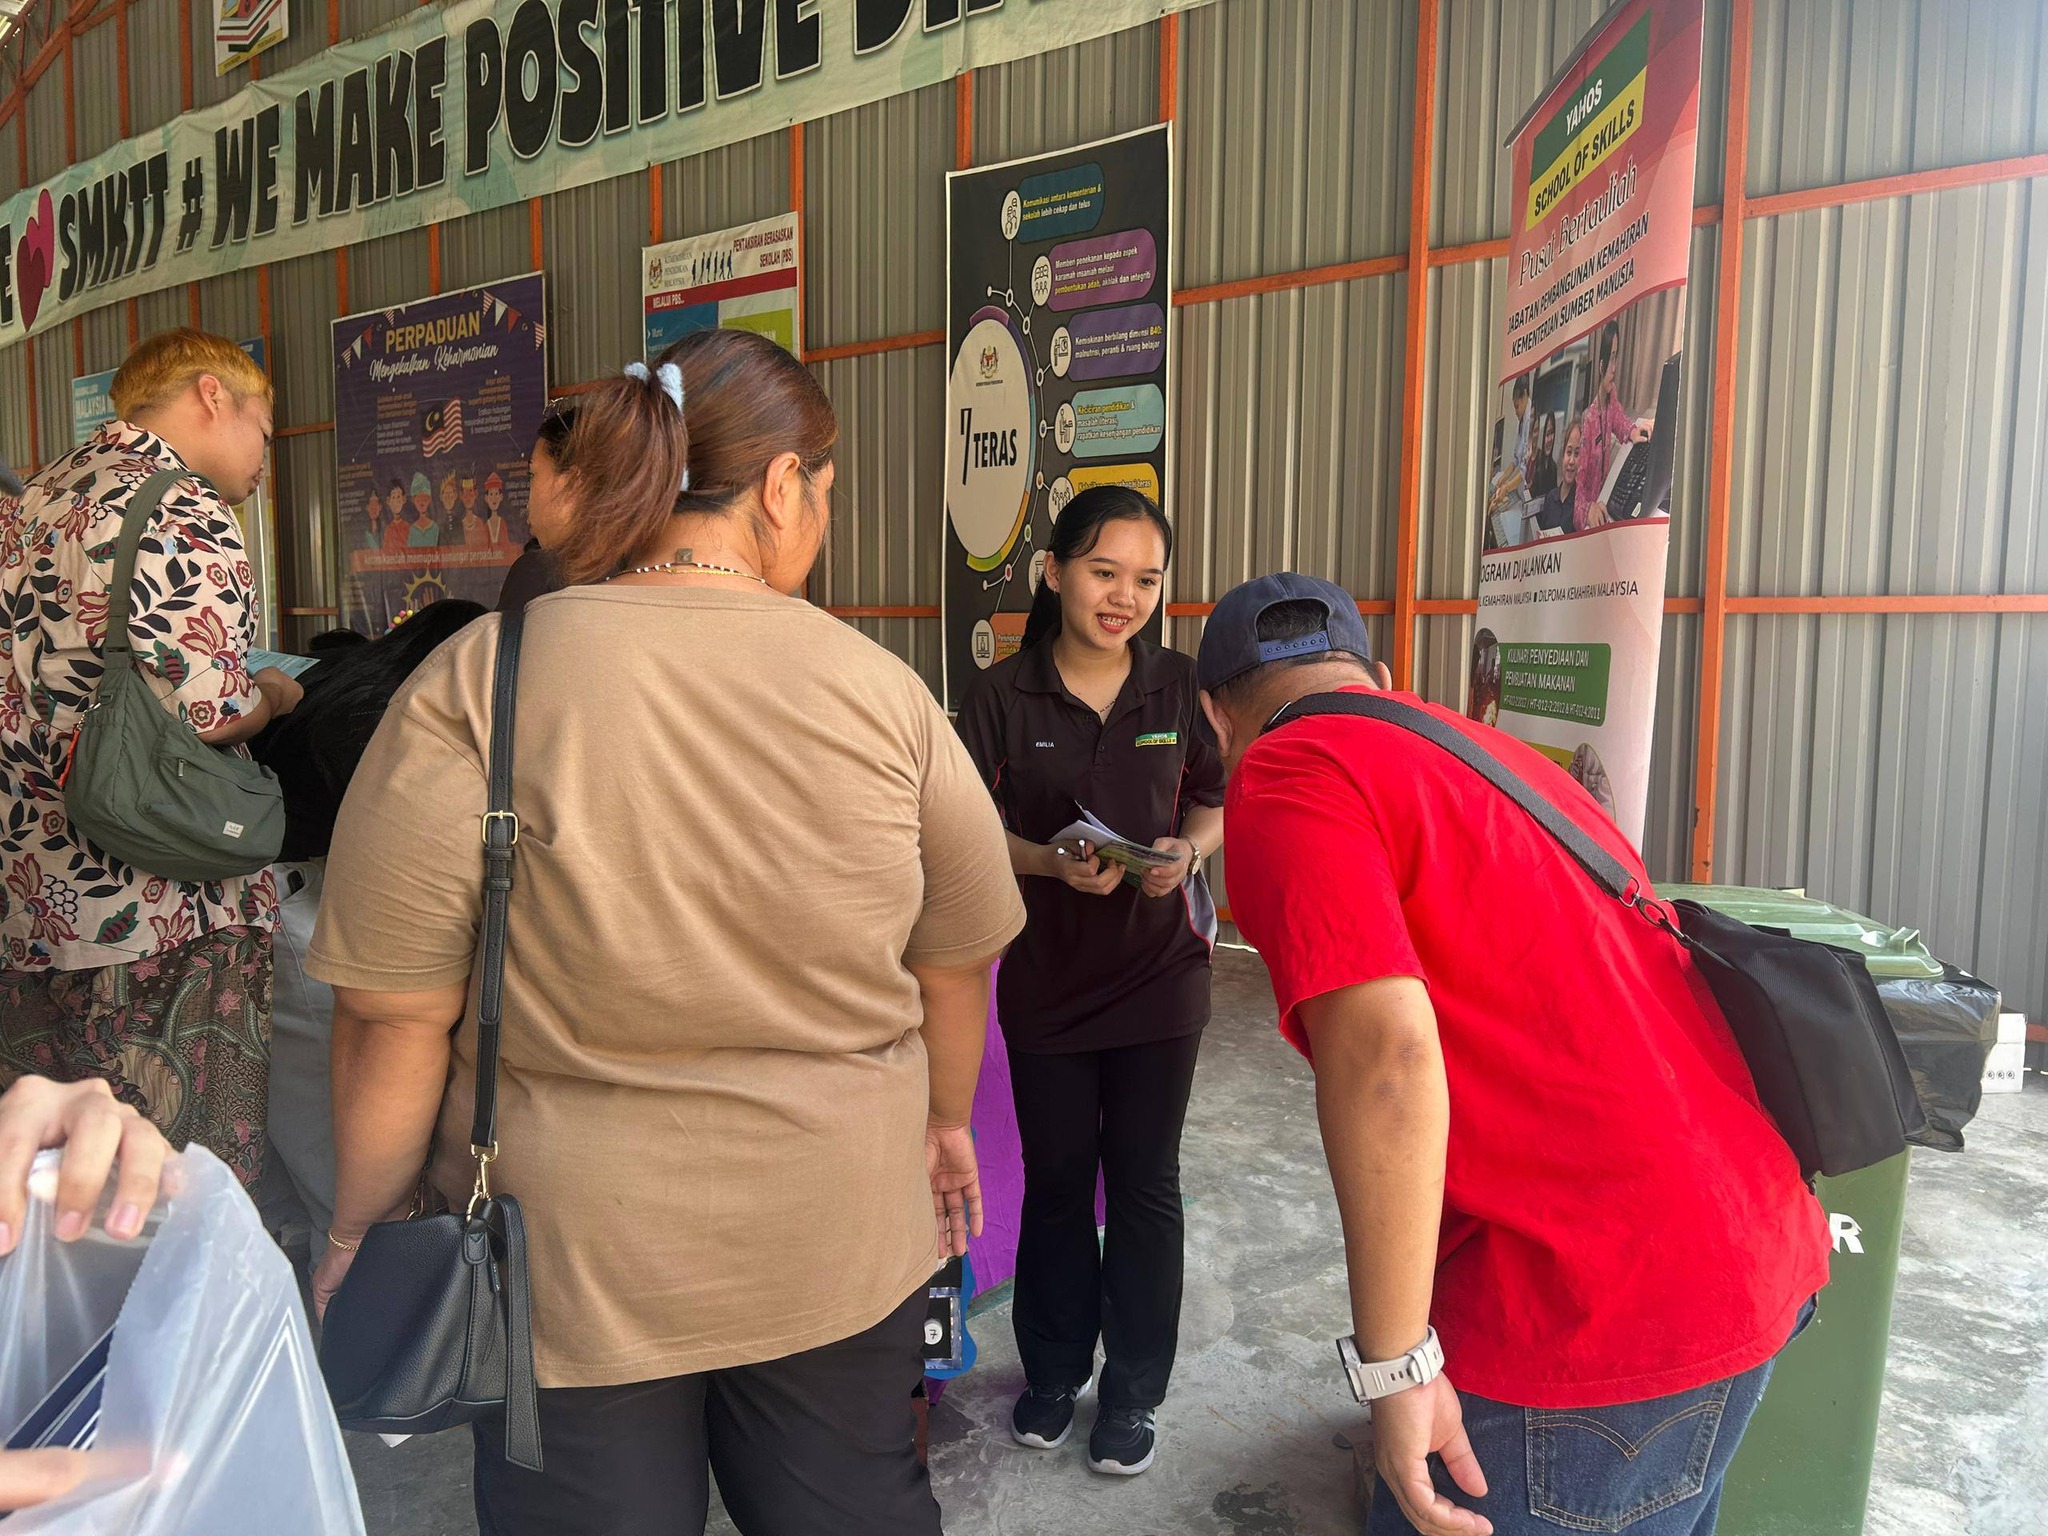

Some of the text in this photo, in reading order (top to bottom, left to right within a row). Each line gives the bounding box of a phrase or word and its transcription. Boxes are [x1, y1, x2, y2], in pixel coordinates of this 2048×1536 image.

[1566, 79, 1603, 136] YAHOS
[58, 150, 169, 304] SMKTT
[292, 33, 448, 226] MAKE
[1534, 99, 1635, 217] SCHOOL OF SKILLS
[1041, 207, 1053, 217] lebih
[1053, 205, 1068, 215] cekap
[1068, 202, 1078, 212] dan
[1078, 199, 1091, 209] telus
[1518, 155, 1637, 288] Pusat Bertauliah
[764, 226, 793, 246] BERASASKAN
[760, 251, 780, 267] SEKOLAH
[1103, 250, 1122, 261] kepada
[1122, 246, 1138, 257] aspek
[1119, 274, 1129, 283] dan
[1507, 210, 1650, 335] JABATAN PEMBANGUNAN KEMAHIRAN
[1511, 257, 1635, 358] KEMENTERIAN SUMBER MANUSIA
[385, 310, 482, 354] PERPADUAN
[1075, 335, 1104, 345] Kemiskinan
[1104, 331, 1128, 342] berbilang
[1128, 327, 1149, 339] dimensi
[1121, 344, 1125, 353] &
[1126, 343, 1141, 353] ruang
[1141, 340, 1161, 351] belajar
[369, 342, 500, 383] Mengekalkan Keharmonian
[1132, 424, 1161, 438] pendidikan
[960, 407, 1017, 486] 7 TERAS
[1512, 552, 1562, 582] DIJALANKAN
[1482, 594, 1513, 607] KEMAHIRAN
[1538, 589, 1567, 603] DILPOMA
[1567, 584, 1597, 600] KEMAHIRAN
[1597, 581, 1638, 598] MALAYSIA
[1529, 649, 1575, 666] PENYEDIAAN
[1575, 650, 1589, 667] DAN
[1505, 671, 1576, 692] PEMBUATAN MAKANAN
[1829, 1213, 1864, 1253] R
